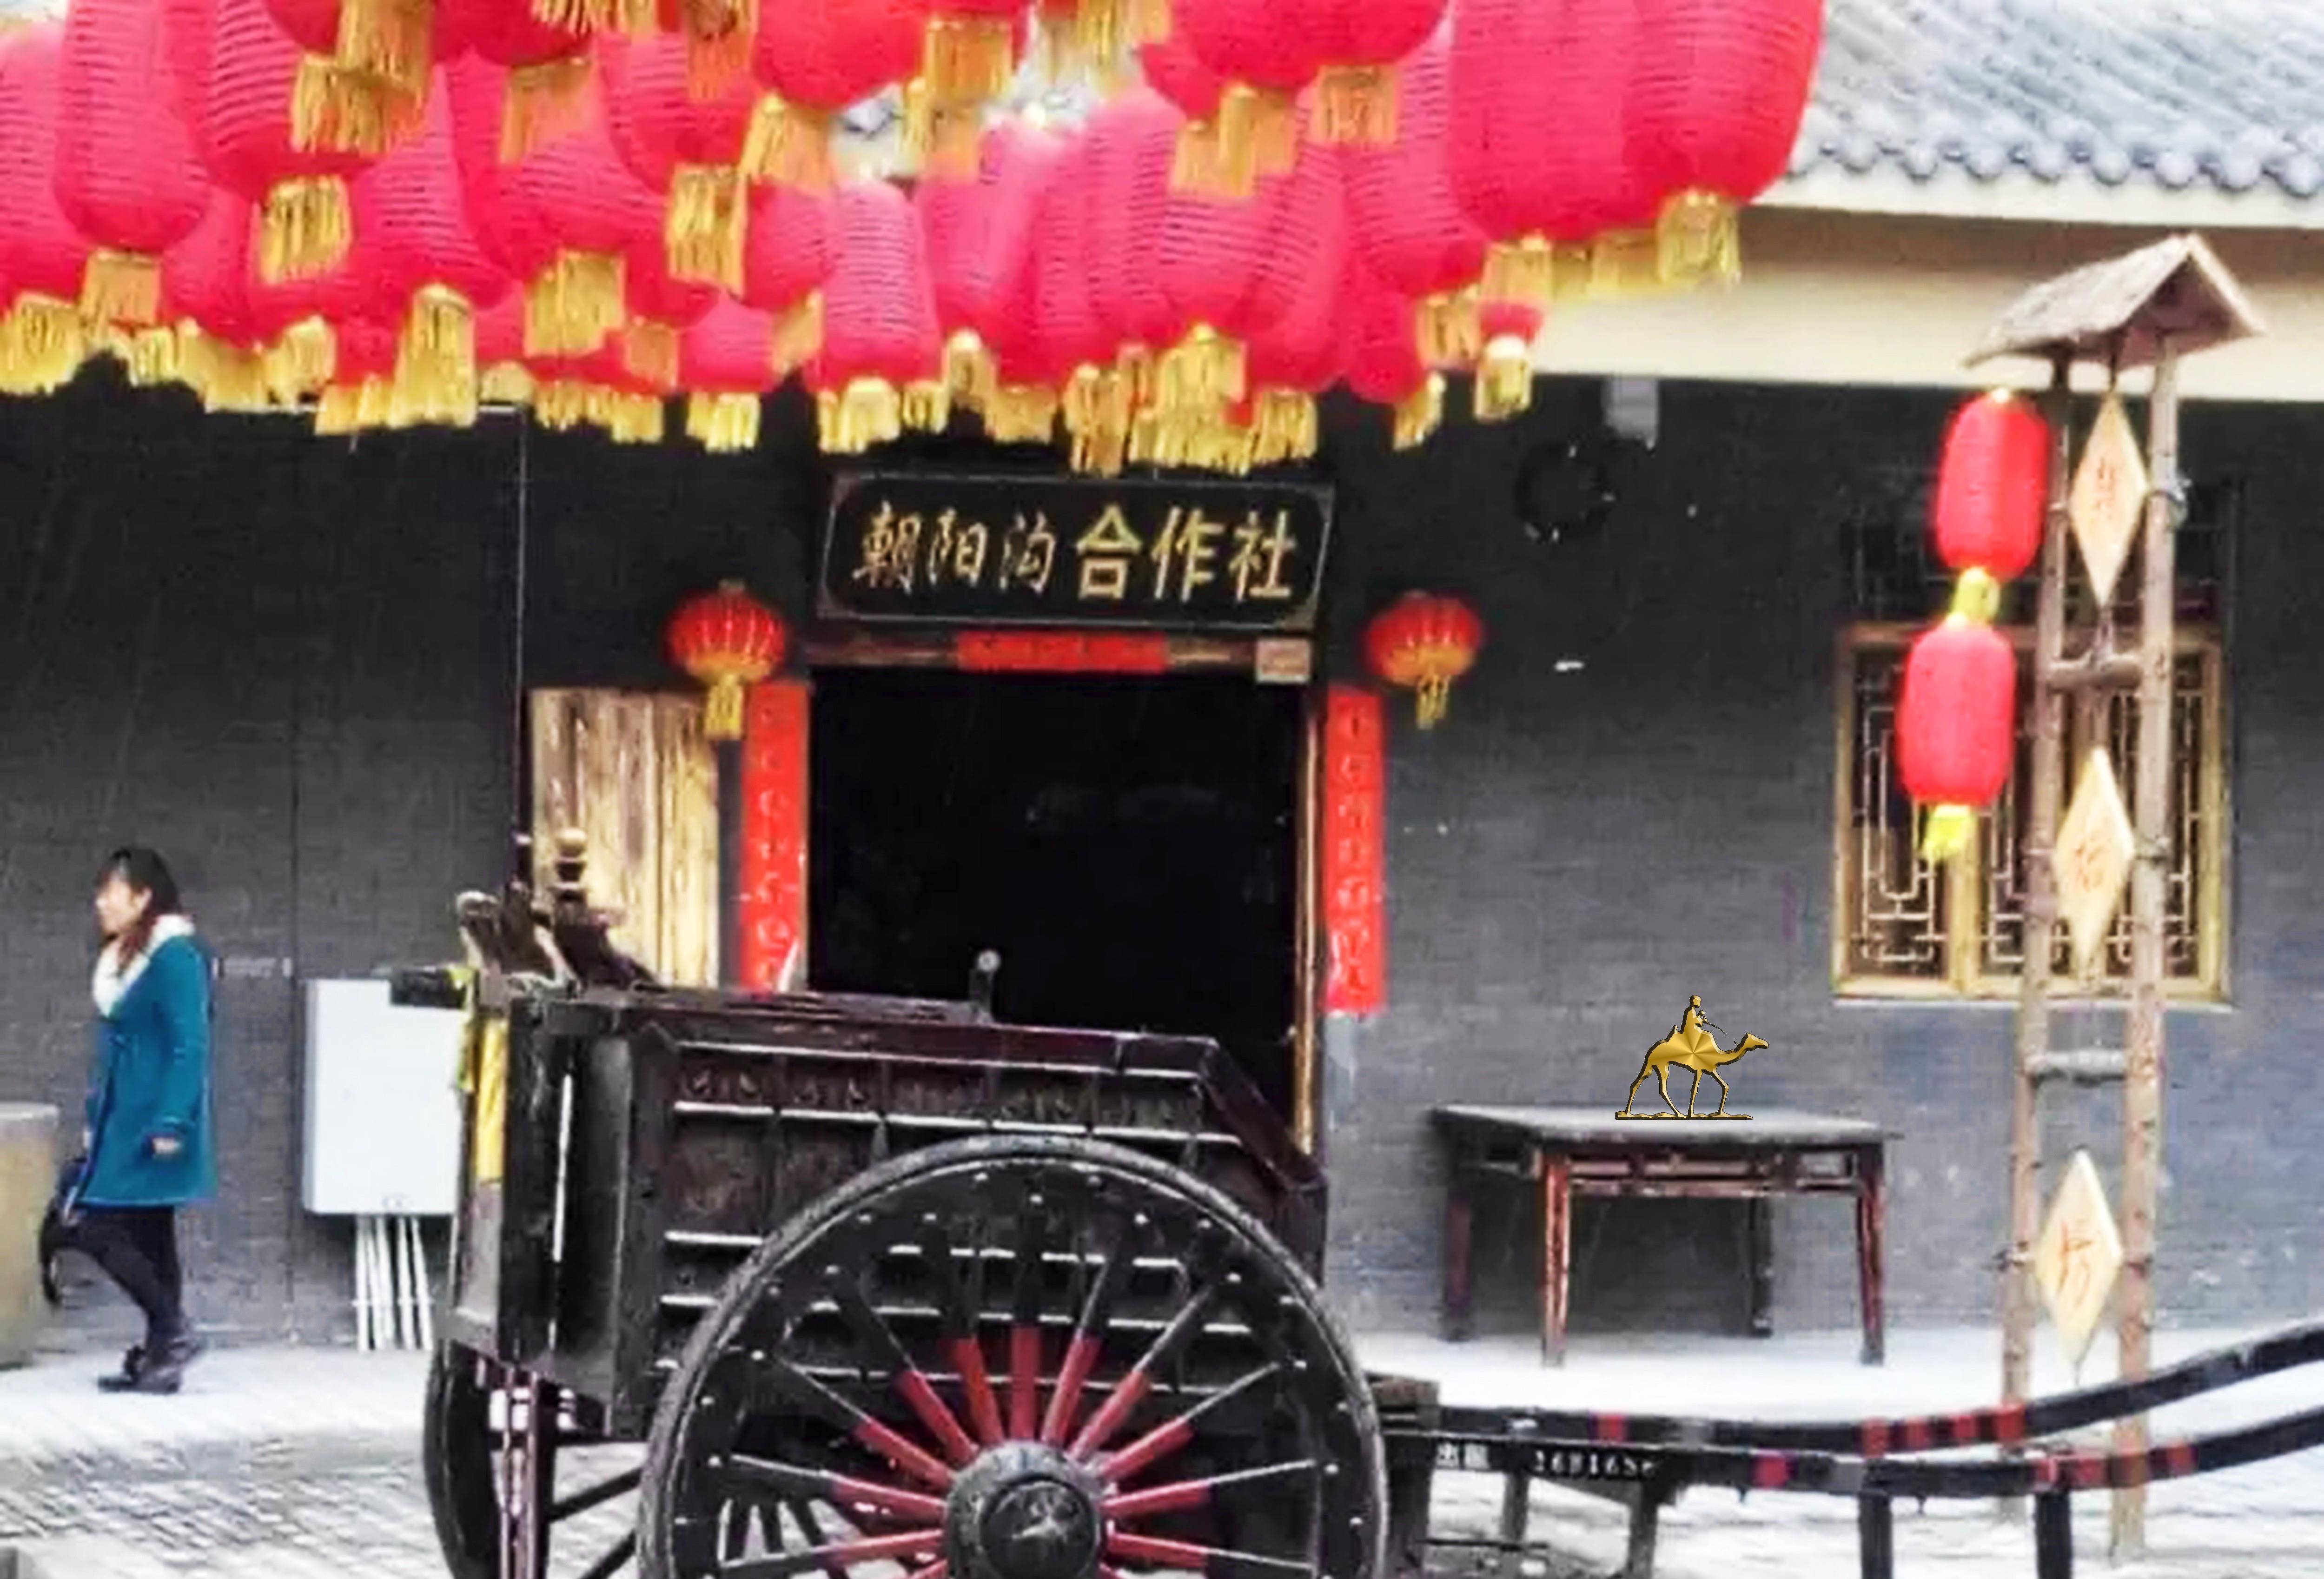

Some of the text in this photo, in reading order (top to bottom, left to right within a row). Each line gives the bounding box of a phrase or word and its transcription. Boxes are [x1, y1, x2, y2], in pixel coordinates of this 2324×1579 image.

[852, 500, 1296, 603] 朝阳沟合作社
